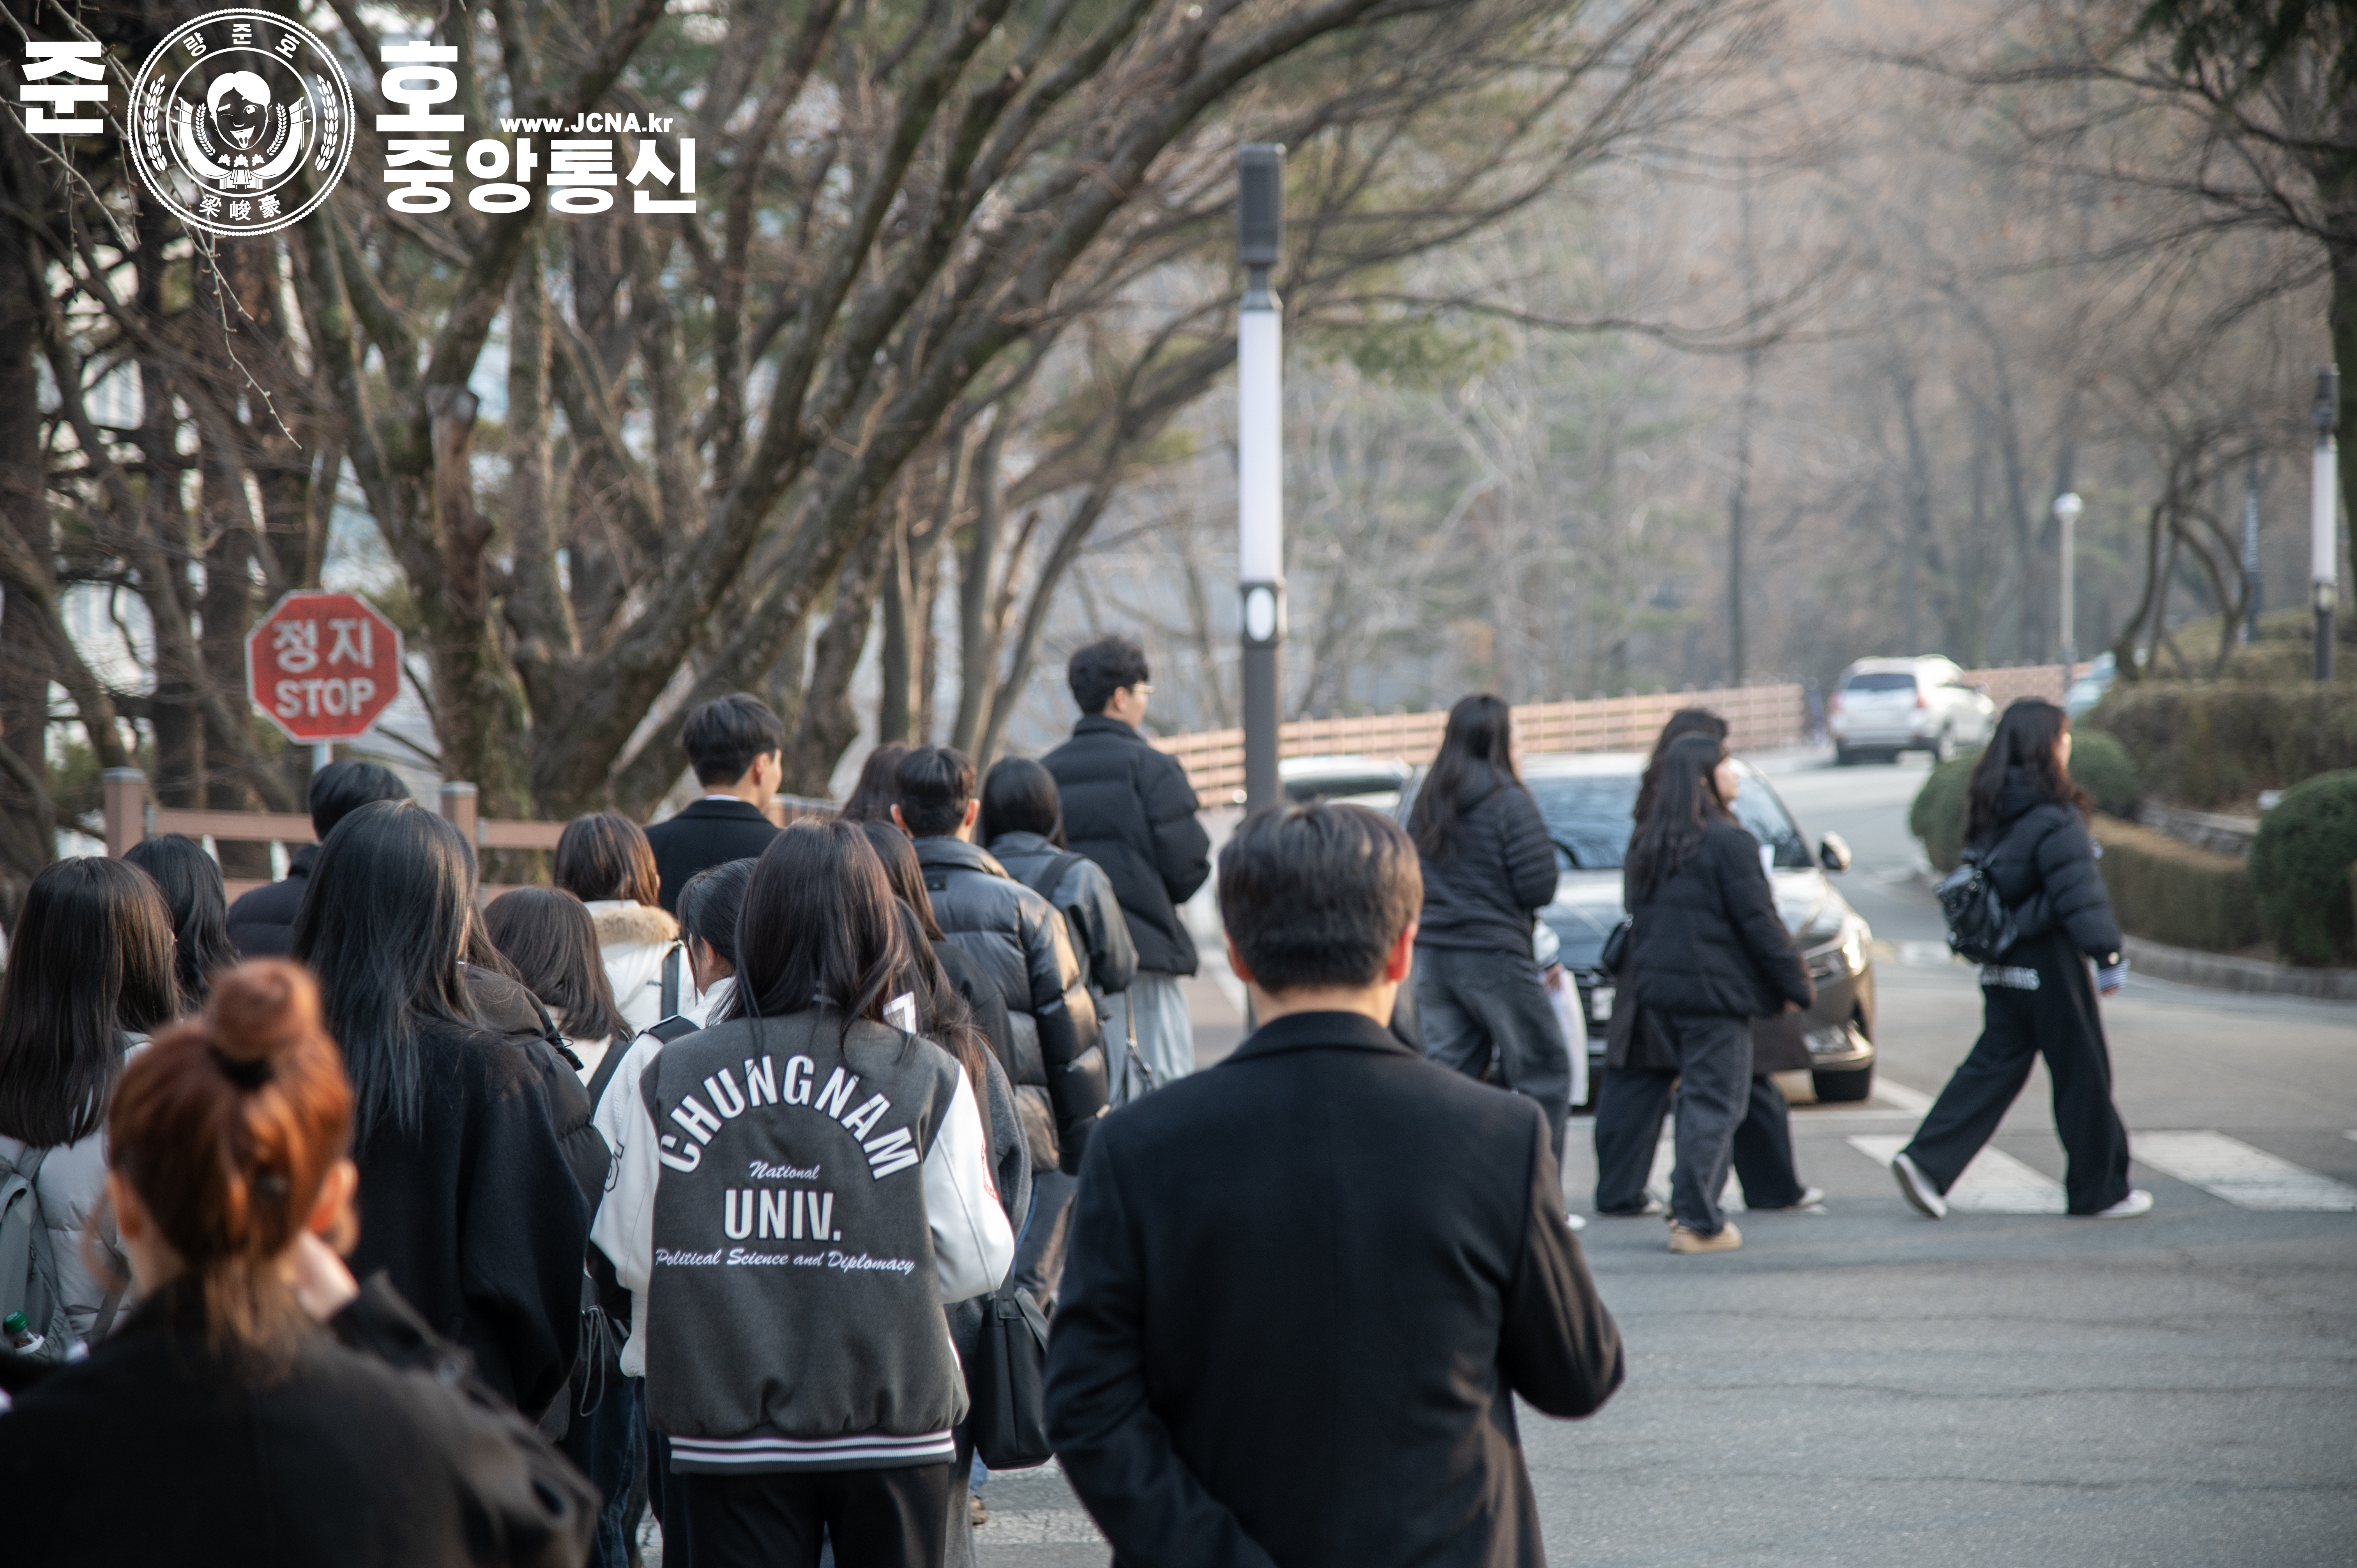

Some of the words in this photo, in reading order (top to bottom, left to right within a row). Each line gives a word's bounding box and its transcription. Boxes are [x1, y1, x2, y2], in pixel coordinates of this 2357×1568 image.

[273, 617, 374, 674] 정지
[274, 677, 377, 719] STOP
[659, 1054, 920, 1180] CHUNGNAM
[749, 1160, 820, 1180] National
[724, 1189, 841, 1241] UNIV.
[656, 1248, 723, 1266] Political
[726, 1247, 789, 1266] Science
[793, 1251, 825, 1266] and
[827, 1250, 915, 1276] Diplomacy
